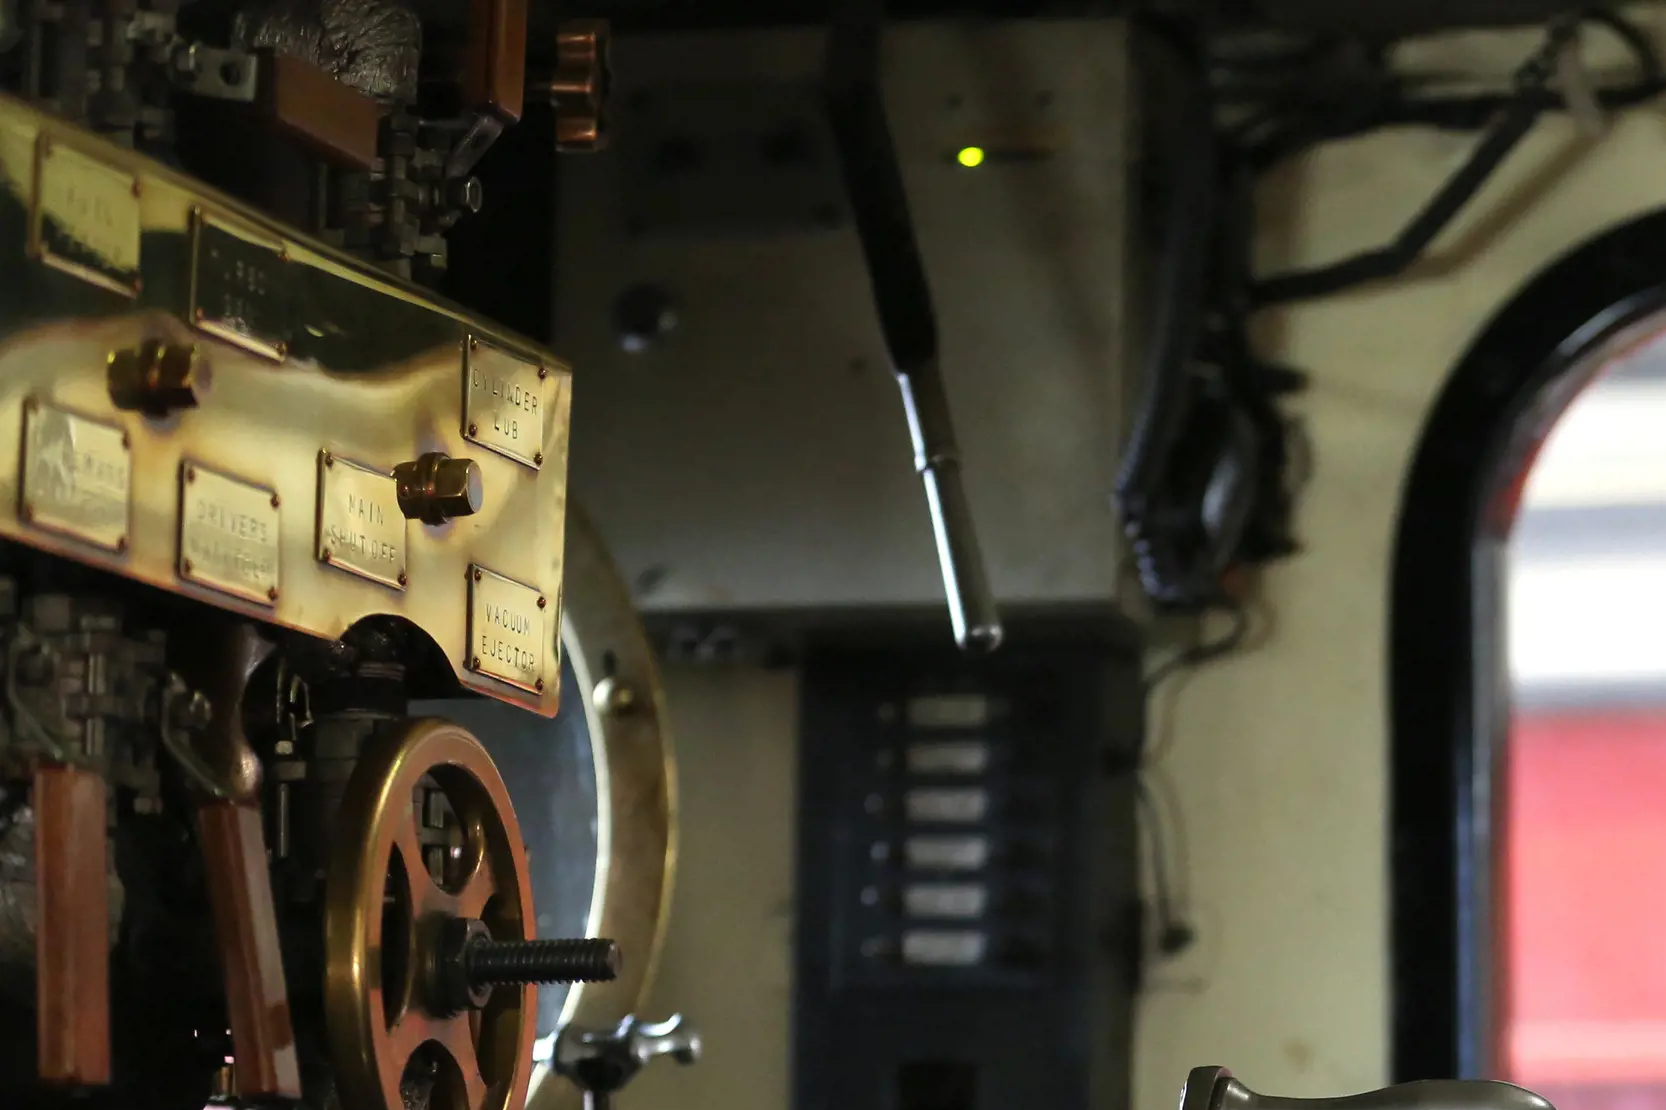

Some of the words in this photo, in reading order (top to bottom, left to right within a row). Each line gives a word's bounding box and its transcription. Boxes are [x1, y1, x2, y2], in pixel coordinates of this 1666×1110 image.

[473, 368, 538, 416] CYLINDER
[493, 410, 518, 440] LUB
[348, 493, 384, 527] MAIN
[485, 603, 530, 636] VACUUM
[481, 635, 536, 672] EJECTOR
